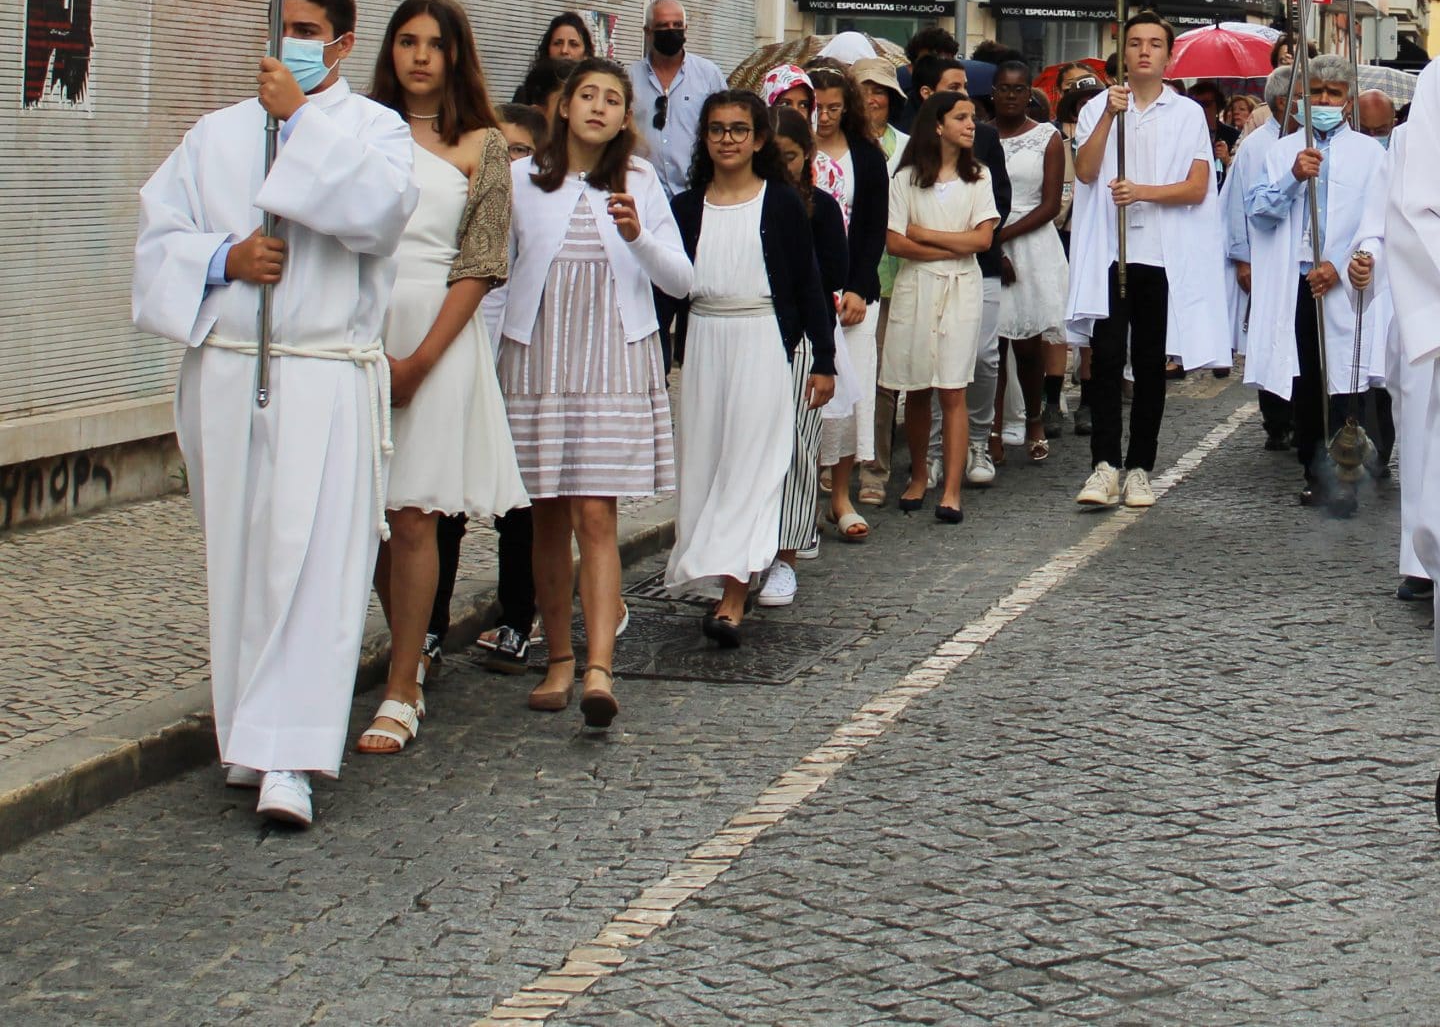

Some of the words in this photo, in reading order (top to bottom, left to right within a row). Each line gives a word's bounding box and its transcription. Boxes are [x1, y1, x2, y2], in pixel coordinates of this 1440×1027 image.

[809, 0, 835, 9] WIDEX
[836, 1, 895, 12] ESPECIALISTAS
[895, 4, 908, 12] EM
[1025, 8, 1076, 18] ESPECIALISTAS
